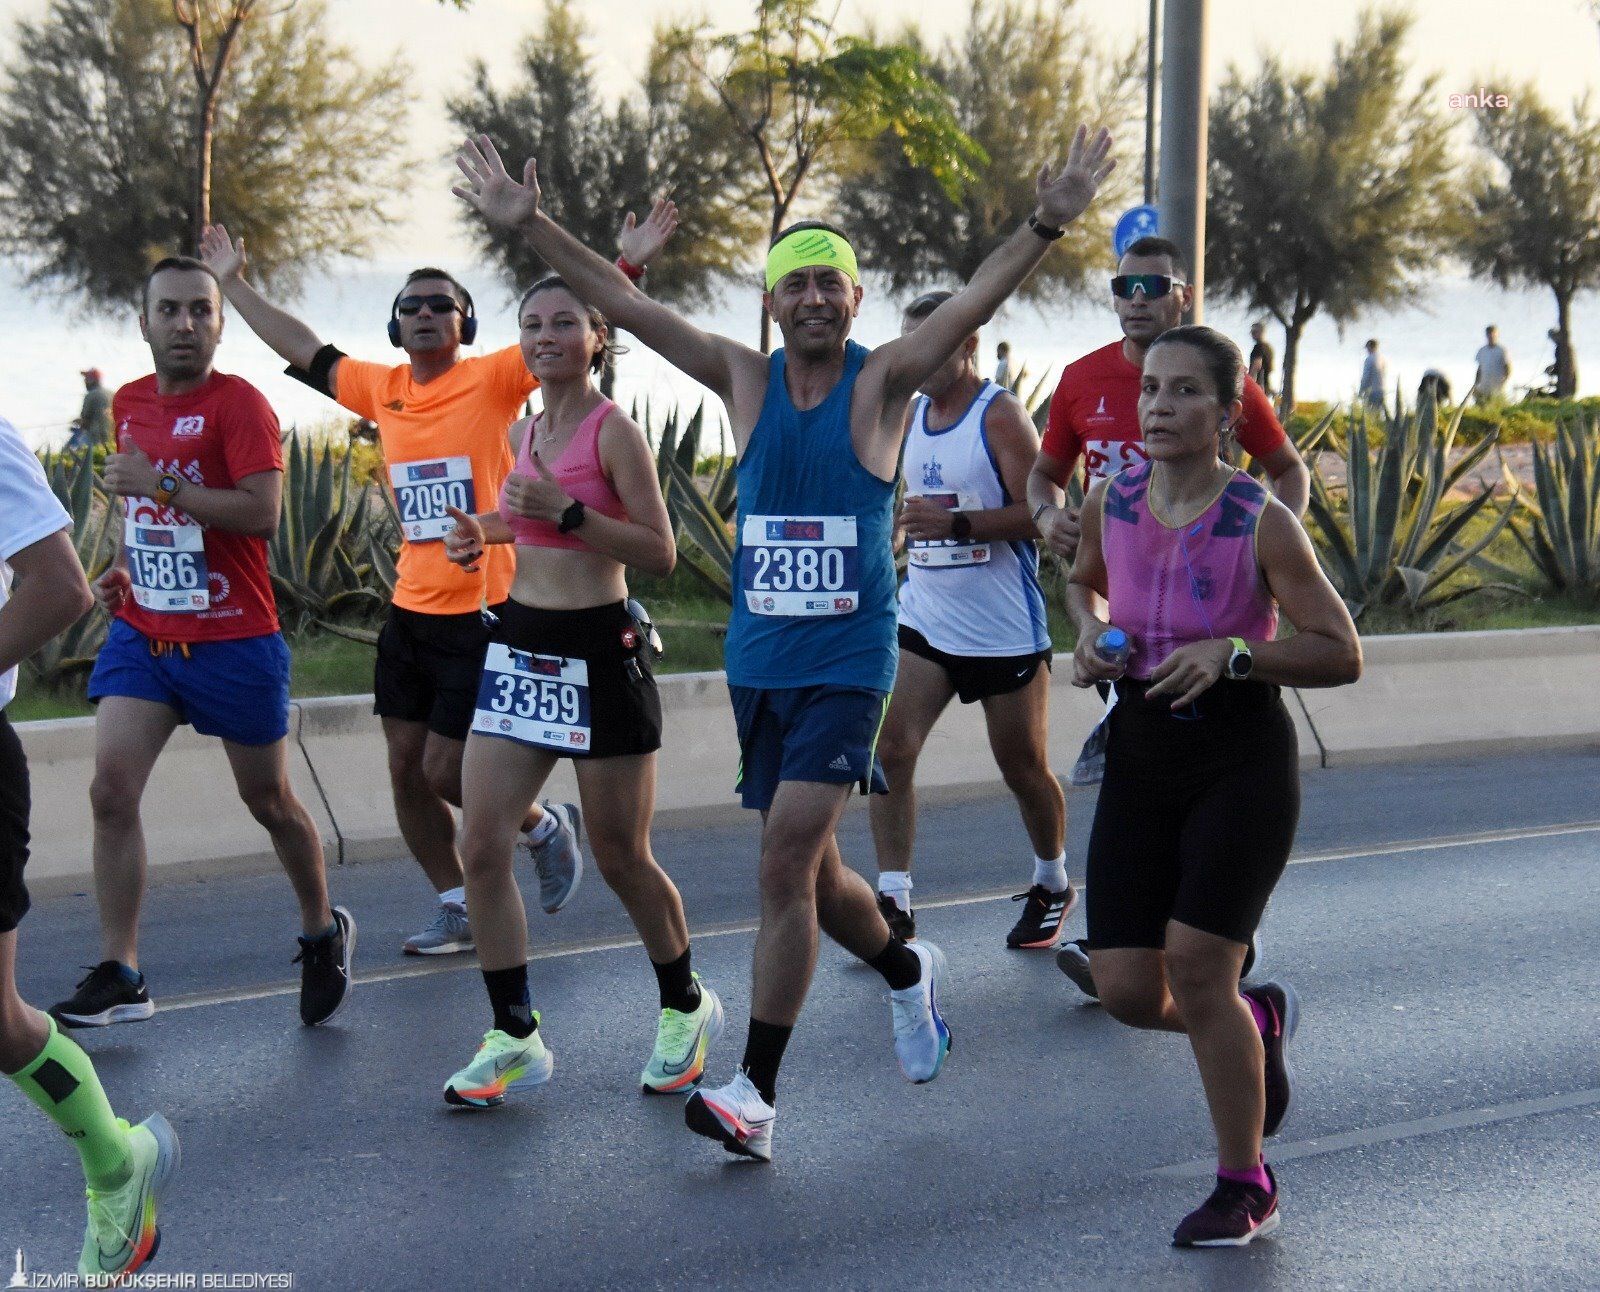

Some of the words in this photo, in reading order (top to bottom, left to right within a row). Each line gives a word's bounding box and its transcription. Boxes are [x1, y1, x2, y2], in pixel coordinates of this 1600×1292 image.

[401, 481, 468, 522] 2090
[131, 552, 198, 590] 1586
[753, 547, 844, 591] 2380
[491, 674, 580, 725] 3359
